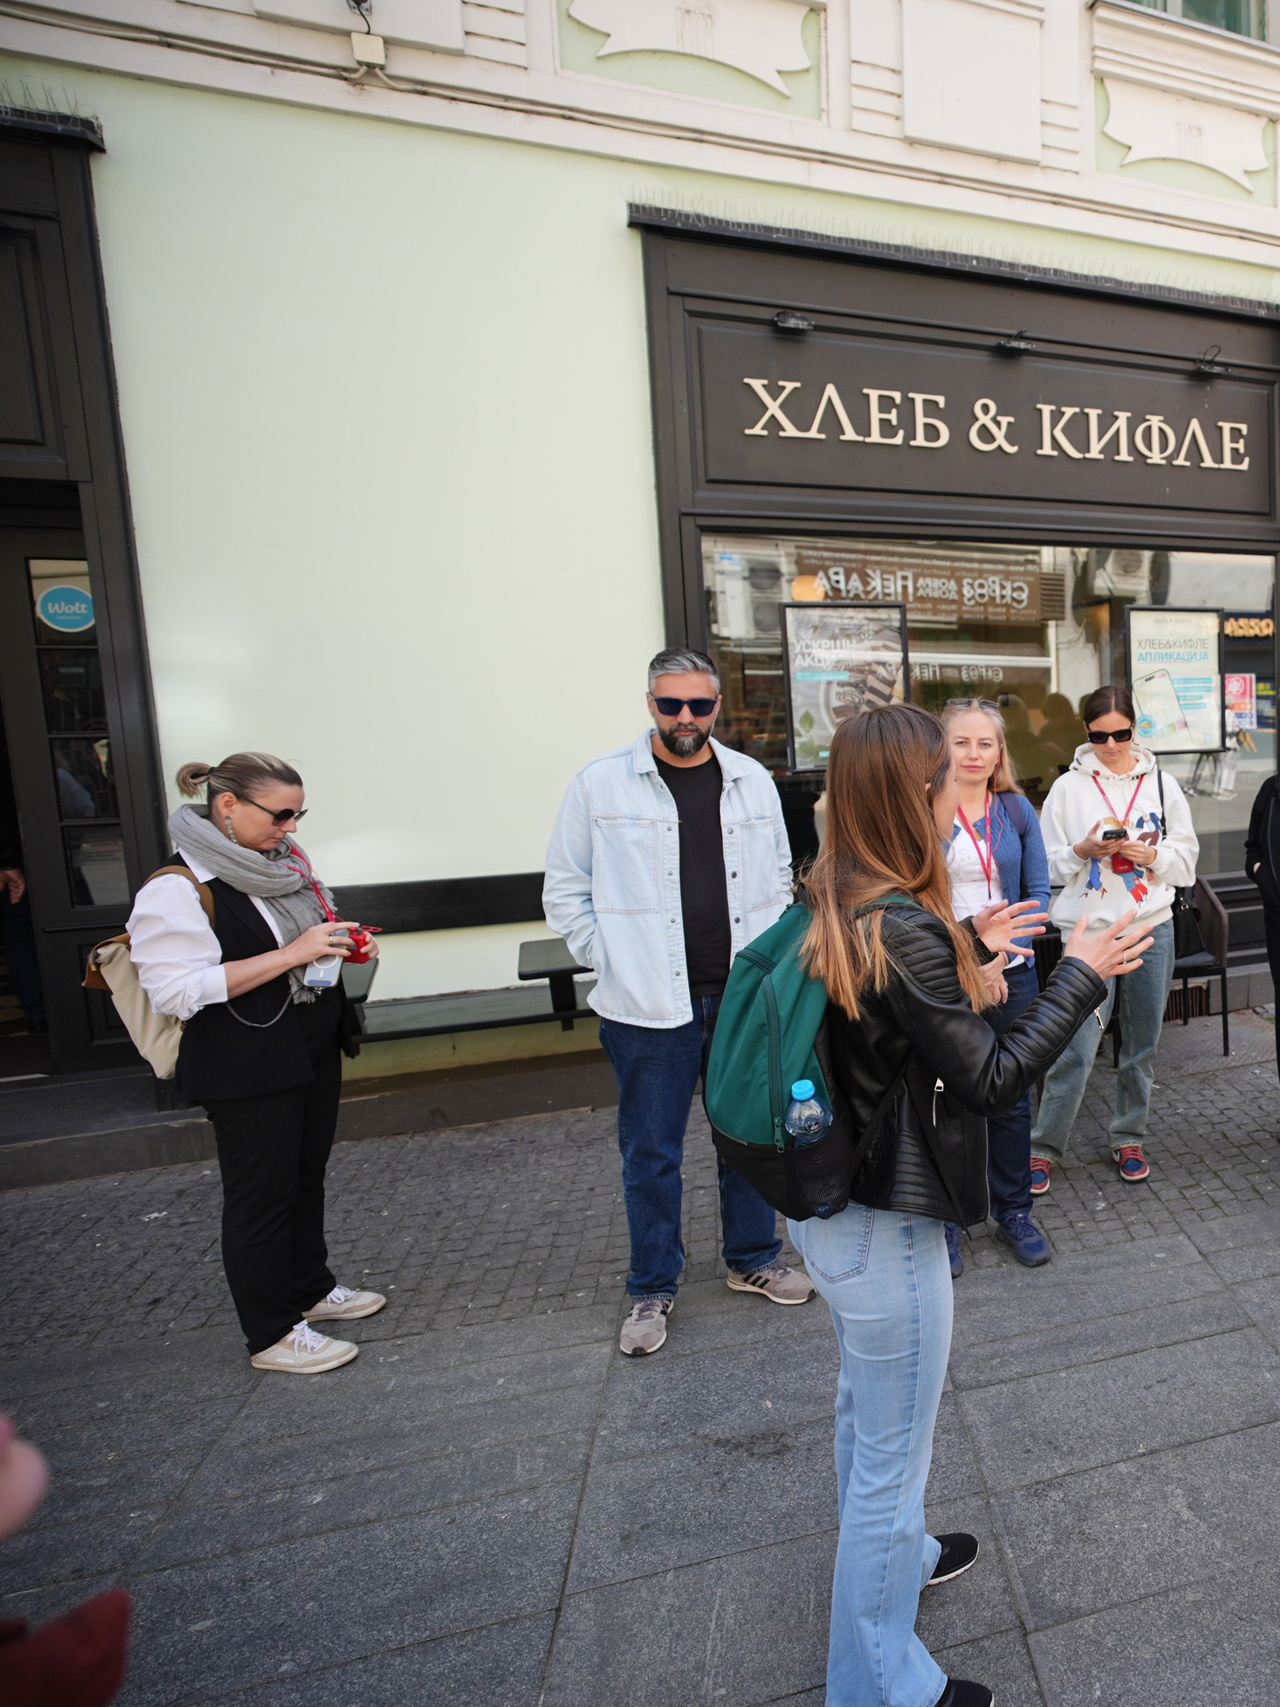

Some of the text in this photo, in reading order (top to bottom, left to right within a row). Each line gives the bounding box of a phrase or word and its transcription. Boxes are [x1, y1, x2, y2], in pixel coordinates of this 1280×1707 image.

[743, 377, 1250, 471] ХЛЕБ & КИФЛЕ
[48, 602, 88, 613] Wolt
[1137, 651, 1210, 662] АПЛИКАЦИЈА
